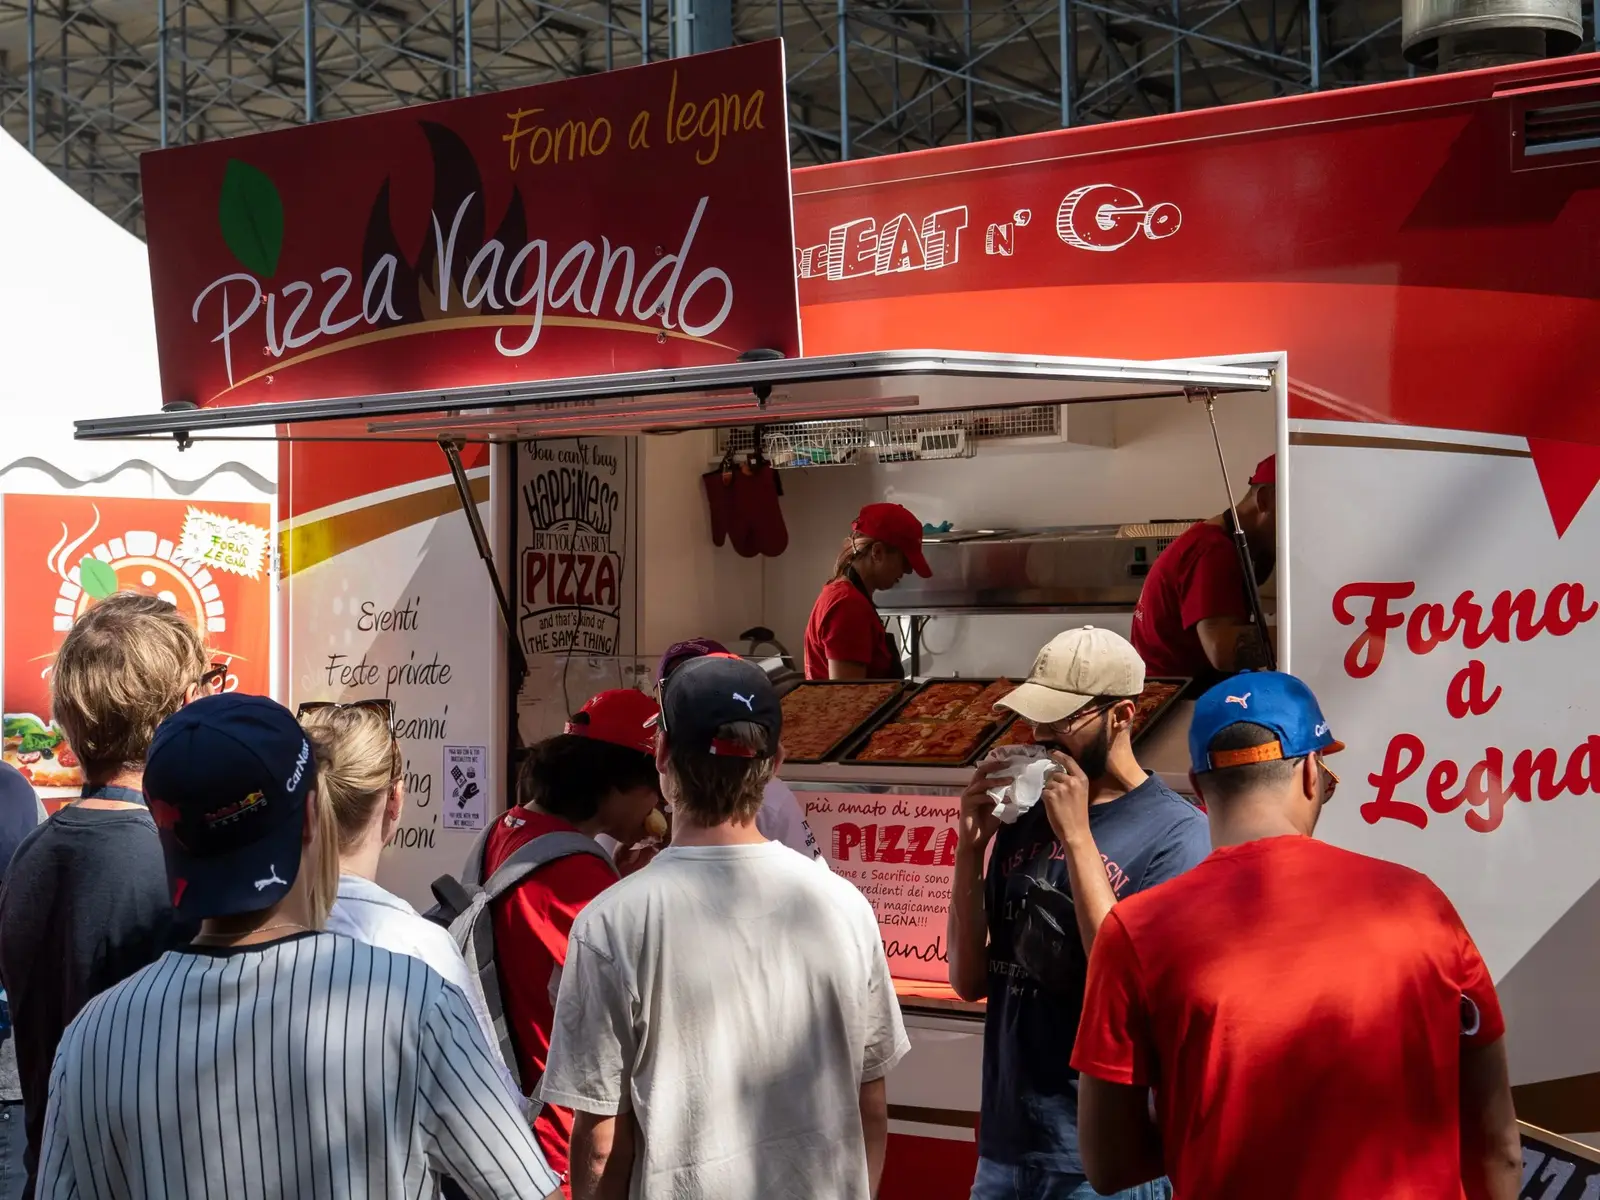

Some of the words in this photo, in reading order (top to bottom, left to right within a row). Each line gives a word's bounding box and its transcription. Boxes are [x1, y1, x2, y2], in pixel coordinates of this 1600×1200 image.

[628, 110, 650, 150] a
[666, 68, 765, 166] legna
[192, 251, 403, 388] Pizza
[430, 191, 734, 357] Vagando
[524, 439, 554, 461] You
[593, 445, 618, 476] buy
[203, 547, 247, 568] LEGNA
[211, 534, 250, 557] FORNO
[536, 532, 553, 550] BUT
[553, 533, 573, 551] YOU
[574, 536, 591, 552] CAN
[591, 536, 608, 553] BUY
[526, 552, 616, 606] PIZZA
[357, 596, 420, 632] Eventi
[540, 613, 553, 630] and
[555, 611, 577, 626] that's
[579, 613, 594, 629] kind
[596, 617, 606, 631] of
[1331, 580, 1599, 679] Forno
[528, 631, 550, 654] THE
[551, 629, 580, 648] SAME
[582, 630, 612, 654] THING
[325, 653, 380, 688] Feste
[386, 651, 453, 699] private
[1446, 659, 1503, 719] a
[394, 701, 448, 740] eanni
[403, 760, 431, 808] ing
[1359, 732, 1600, 833] Legna
[805, 797, 832, 817] più
[837, 801, 887, 816] amato
[892, 800, 911, 817] di
[832, 822, 959, 867] PIZZA
[856, 883, 904, 897] redienti
[907, 886, 924, 898] dei
[928, 890, 953, 900] nost
[861, 871, 867, 879] e
[871, 869, 921, 882] Sacrificio
[924, 875, 950, 884] sono
